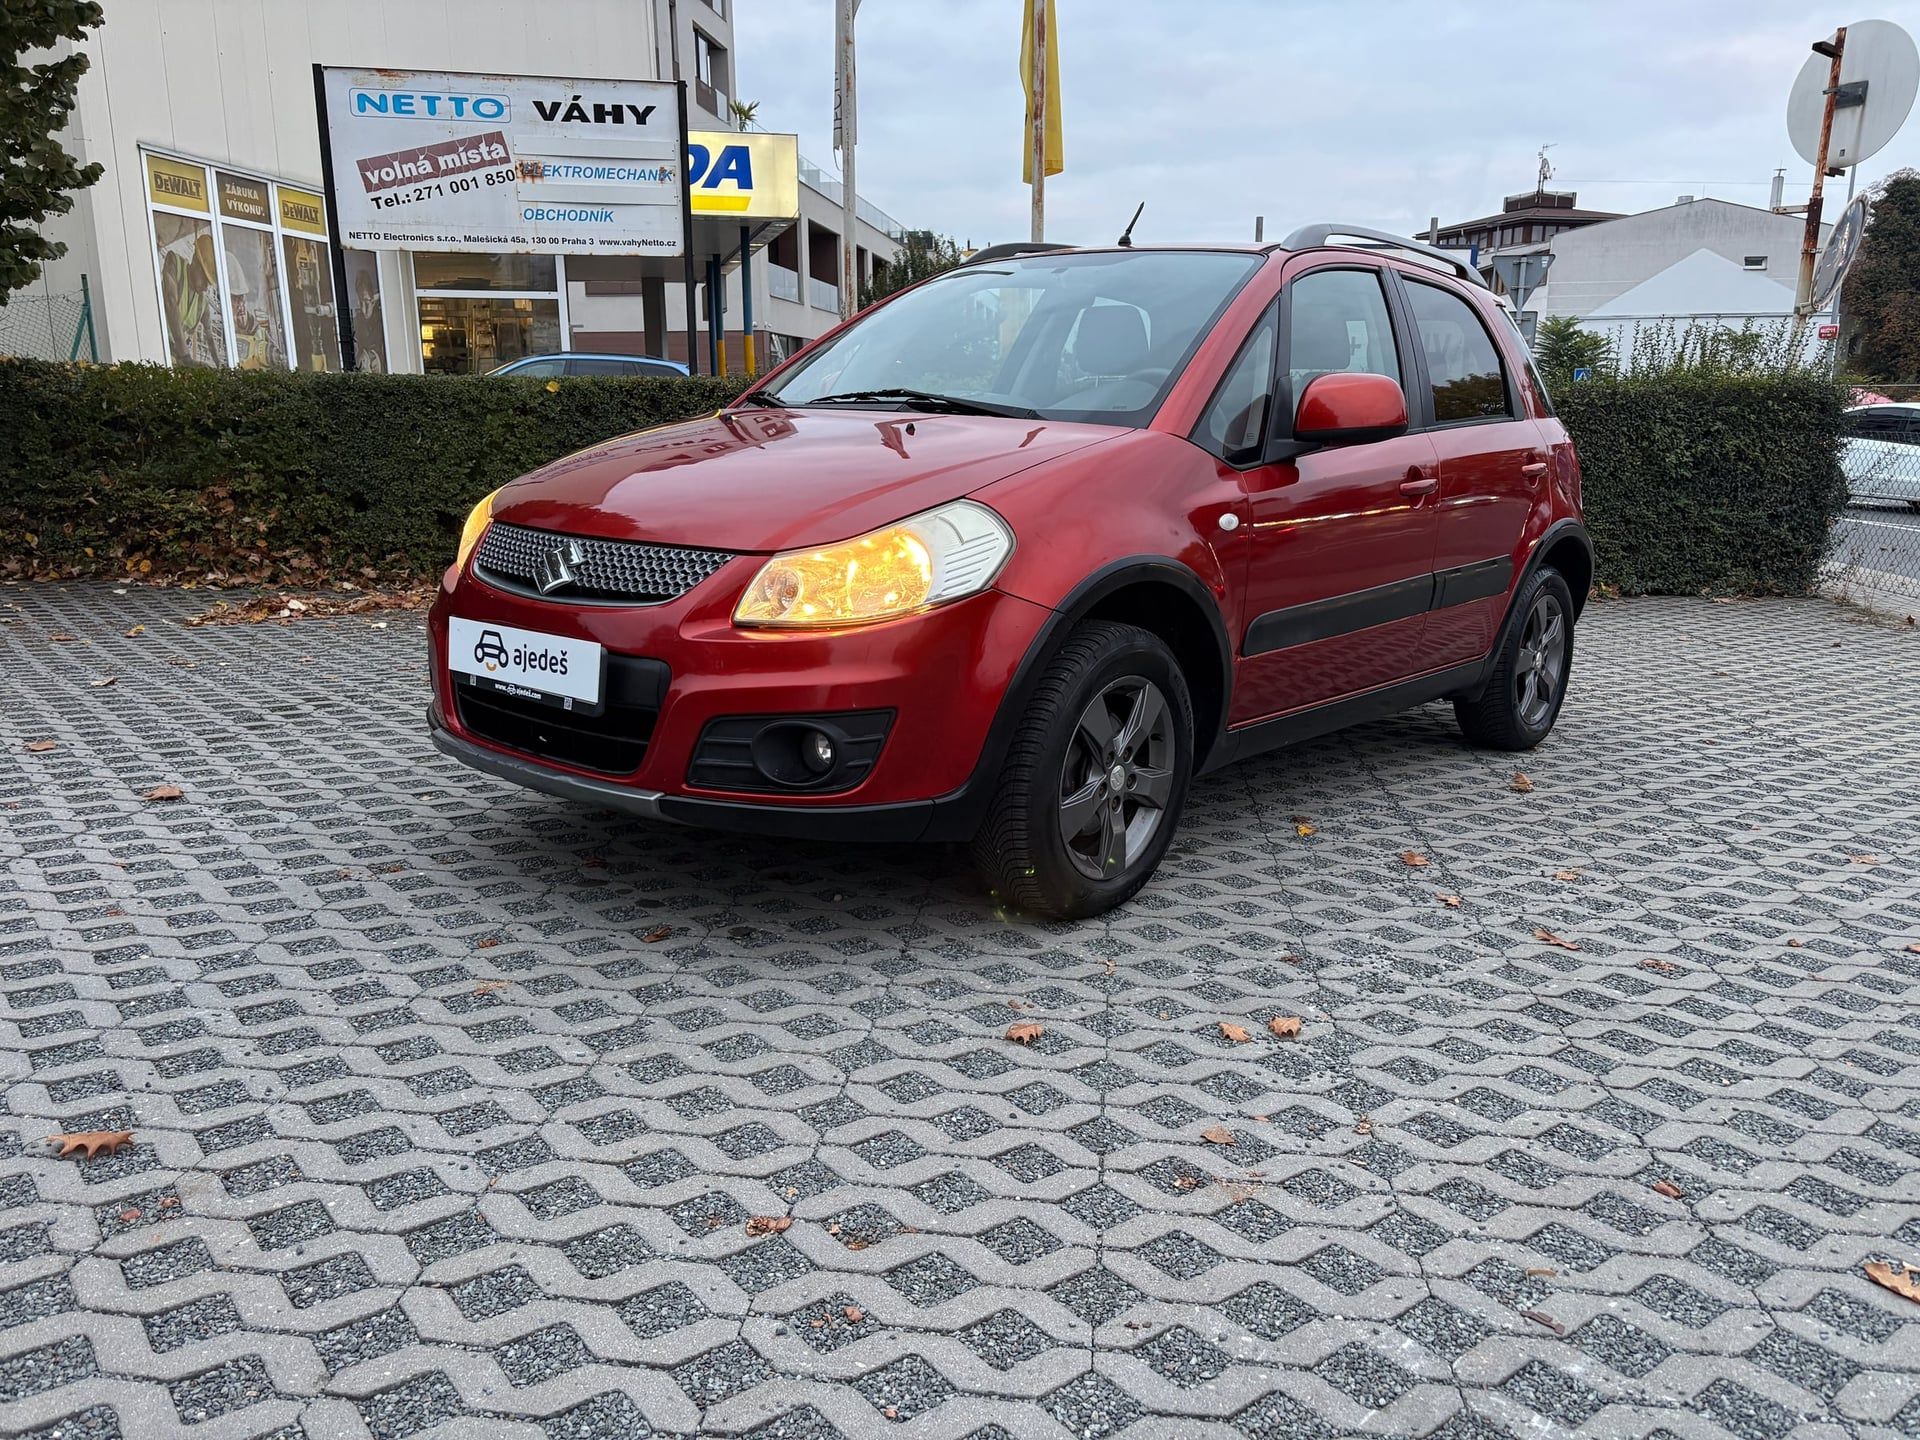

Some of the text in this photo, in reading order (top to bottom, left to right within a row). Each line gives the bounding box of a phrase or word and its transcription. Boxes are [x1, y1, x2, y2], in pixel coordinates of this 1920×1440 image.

[356, 93, 656, 125] NETTO VÁHY
[365, 140, 507, 184] volná místa
[225, 182, 259, 200] ZÁRUKA
[370, 169, 516, 210] Tel.: 271 001 850
[523, 207, 615, 223] OBCHODNÍK
[348, 231, 381, 241] NETTO
[383, 233, 434, 243] Electronics
[436, 234, 462, 244] s.r.o.,
[463, 234, 509, 244] Malešická
[531, 236, 547, 245] 130
[548, 236, 560, 245] 00
[561, 238, 587, 246] Praha
[588, 238, 595, 246] 3
[599, 238, 677, 248] www.vahyNetto.cz
[513, 643, 568, 676] ajedeš
